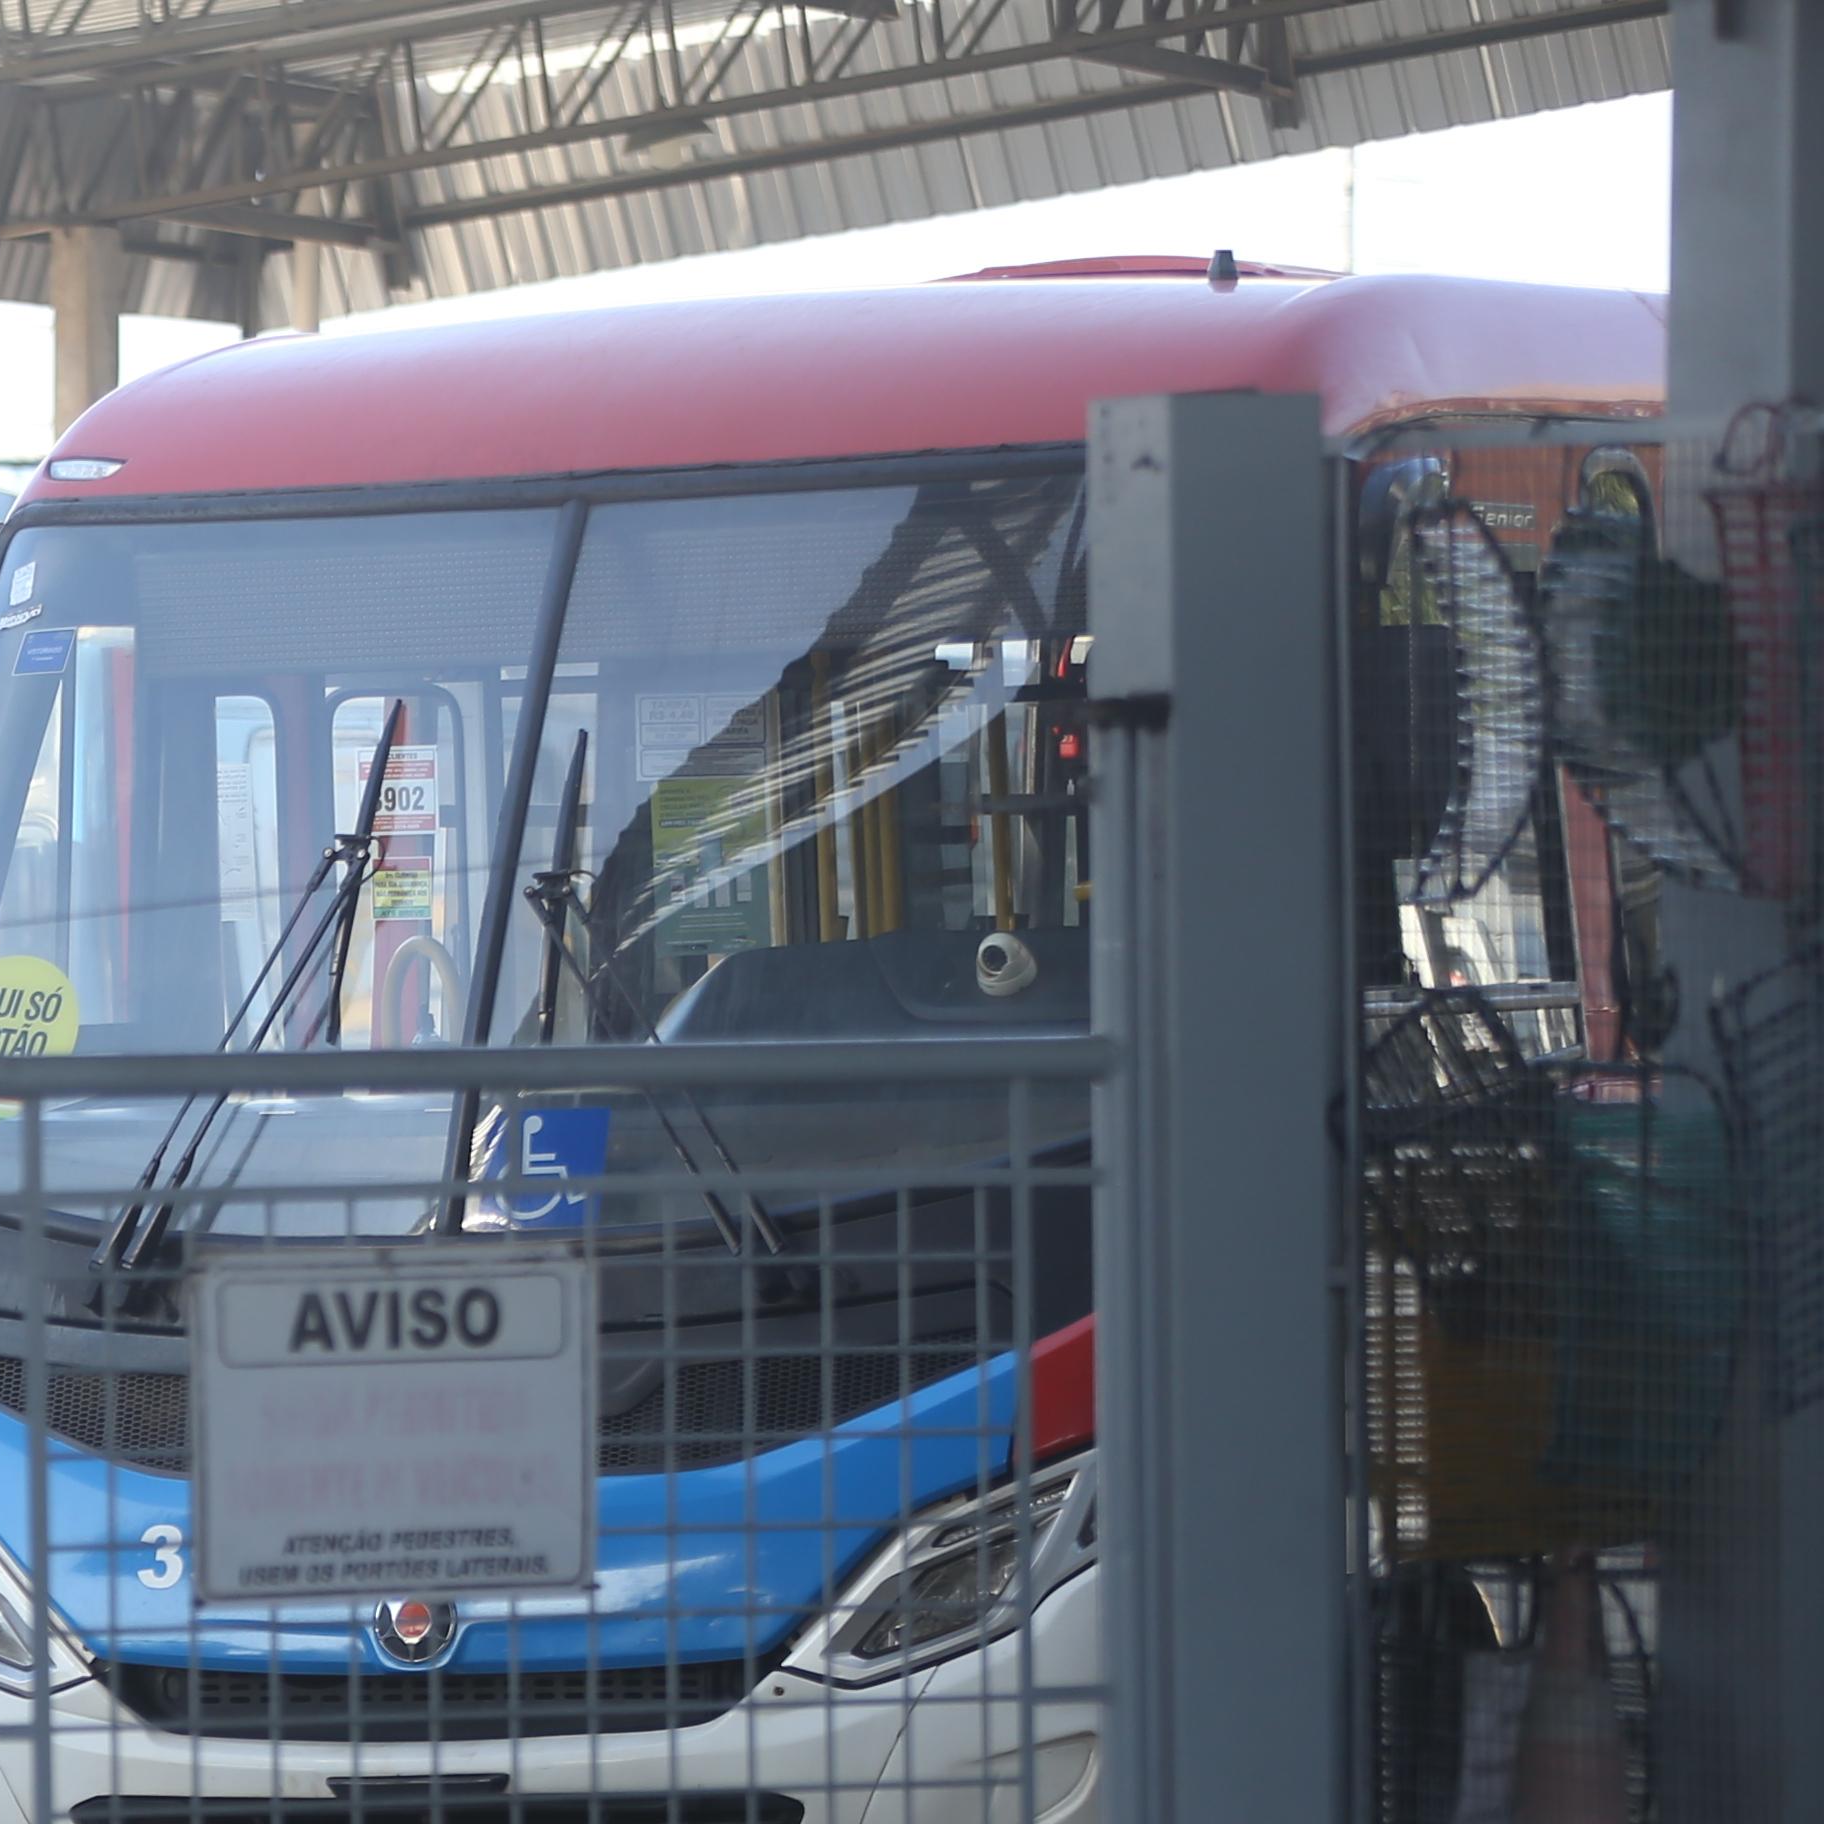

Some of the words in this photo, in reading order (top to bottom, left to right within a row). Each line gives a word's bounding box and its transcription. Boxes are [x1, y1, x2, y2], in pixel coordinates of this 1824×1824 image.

[25, 986, 64, 1024] SÓ
[288, 1287, 502, 1353] AVISO
[283, 1533, 382, 1557] ATENÇÃO
[239, 1563, 299, 1586] USEM
[305, 1563, 335, 1582] OS
[341, 1555, 438, 1581] PORTÕES
